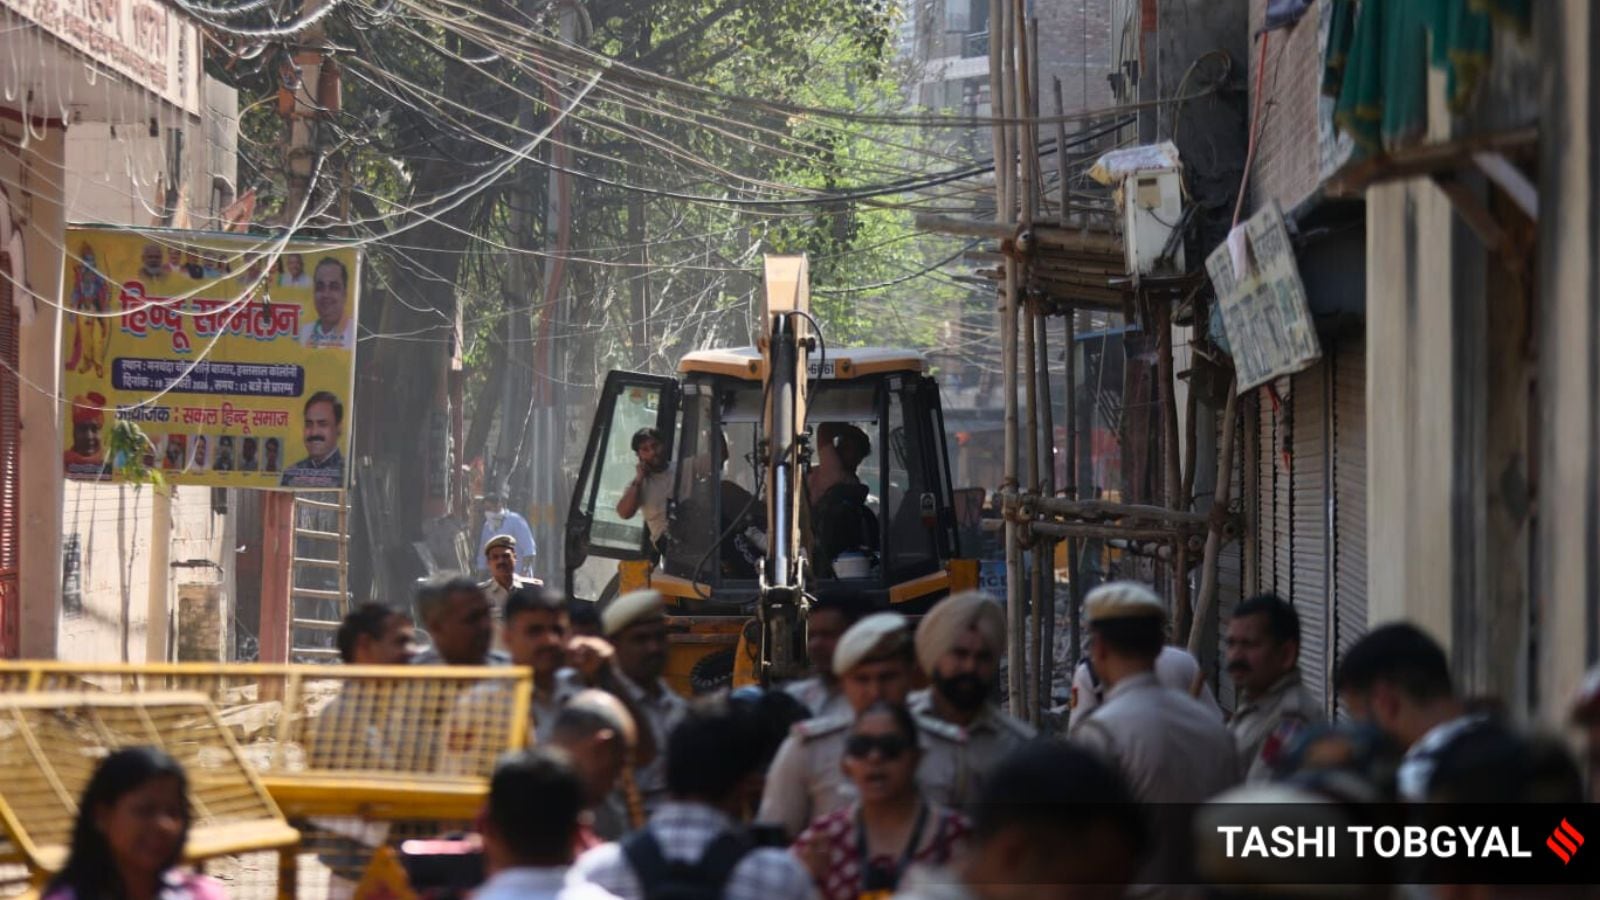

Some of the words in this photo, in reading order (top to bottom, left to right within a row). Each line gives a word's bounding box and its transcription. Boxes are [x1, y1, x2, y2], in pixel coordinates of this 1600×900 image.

[118, 281, 191, 353] हिन्दू
[182, 406, 217, 425] सकल
[221, 402, 251, 434] हिन्दू
[252, 409, 289, 427] समाज
